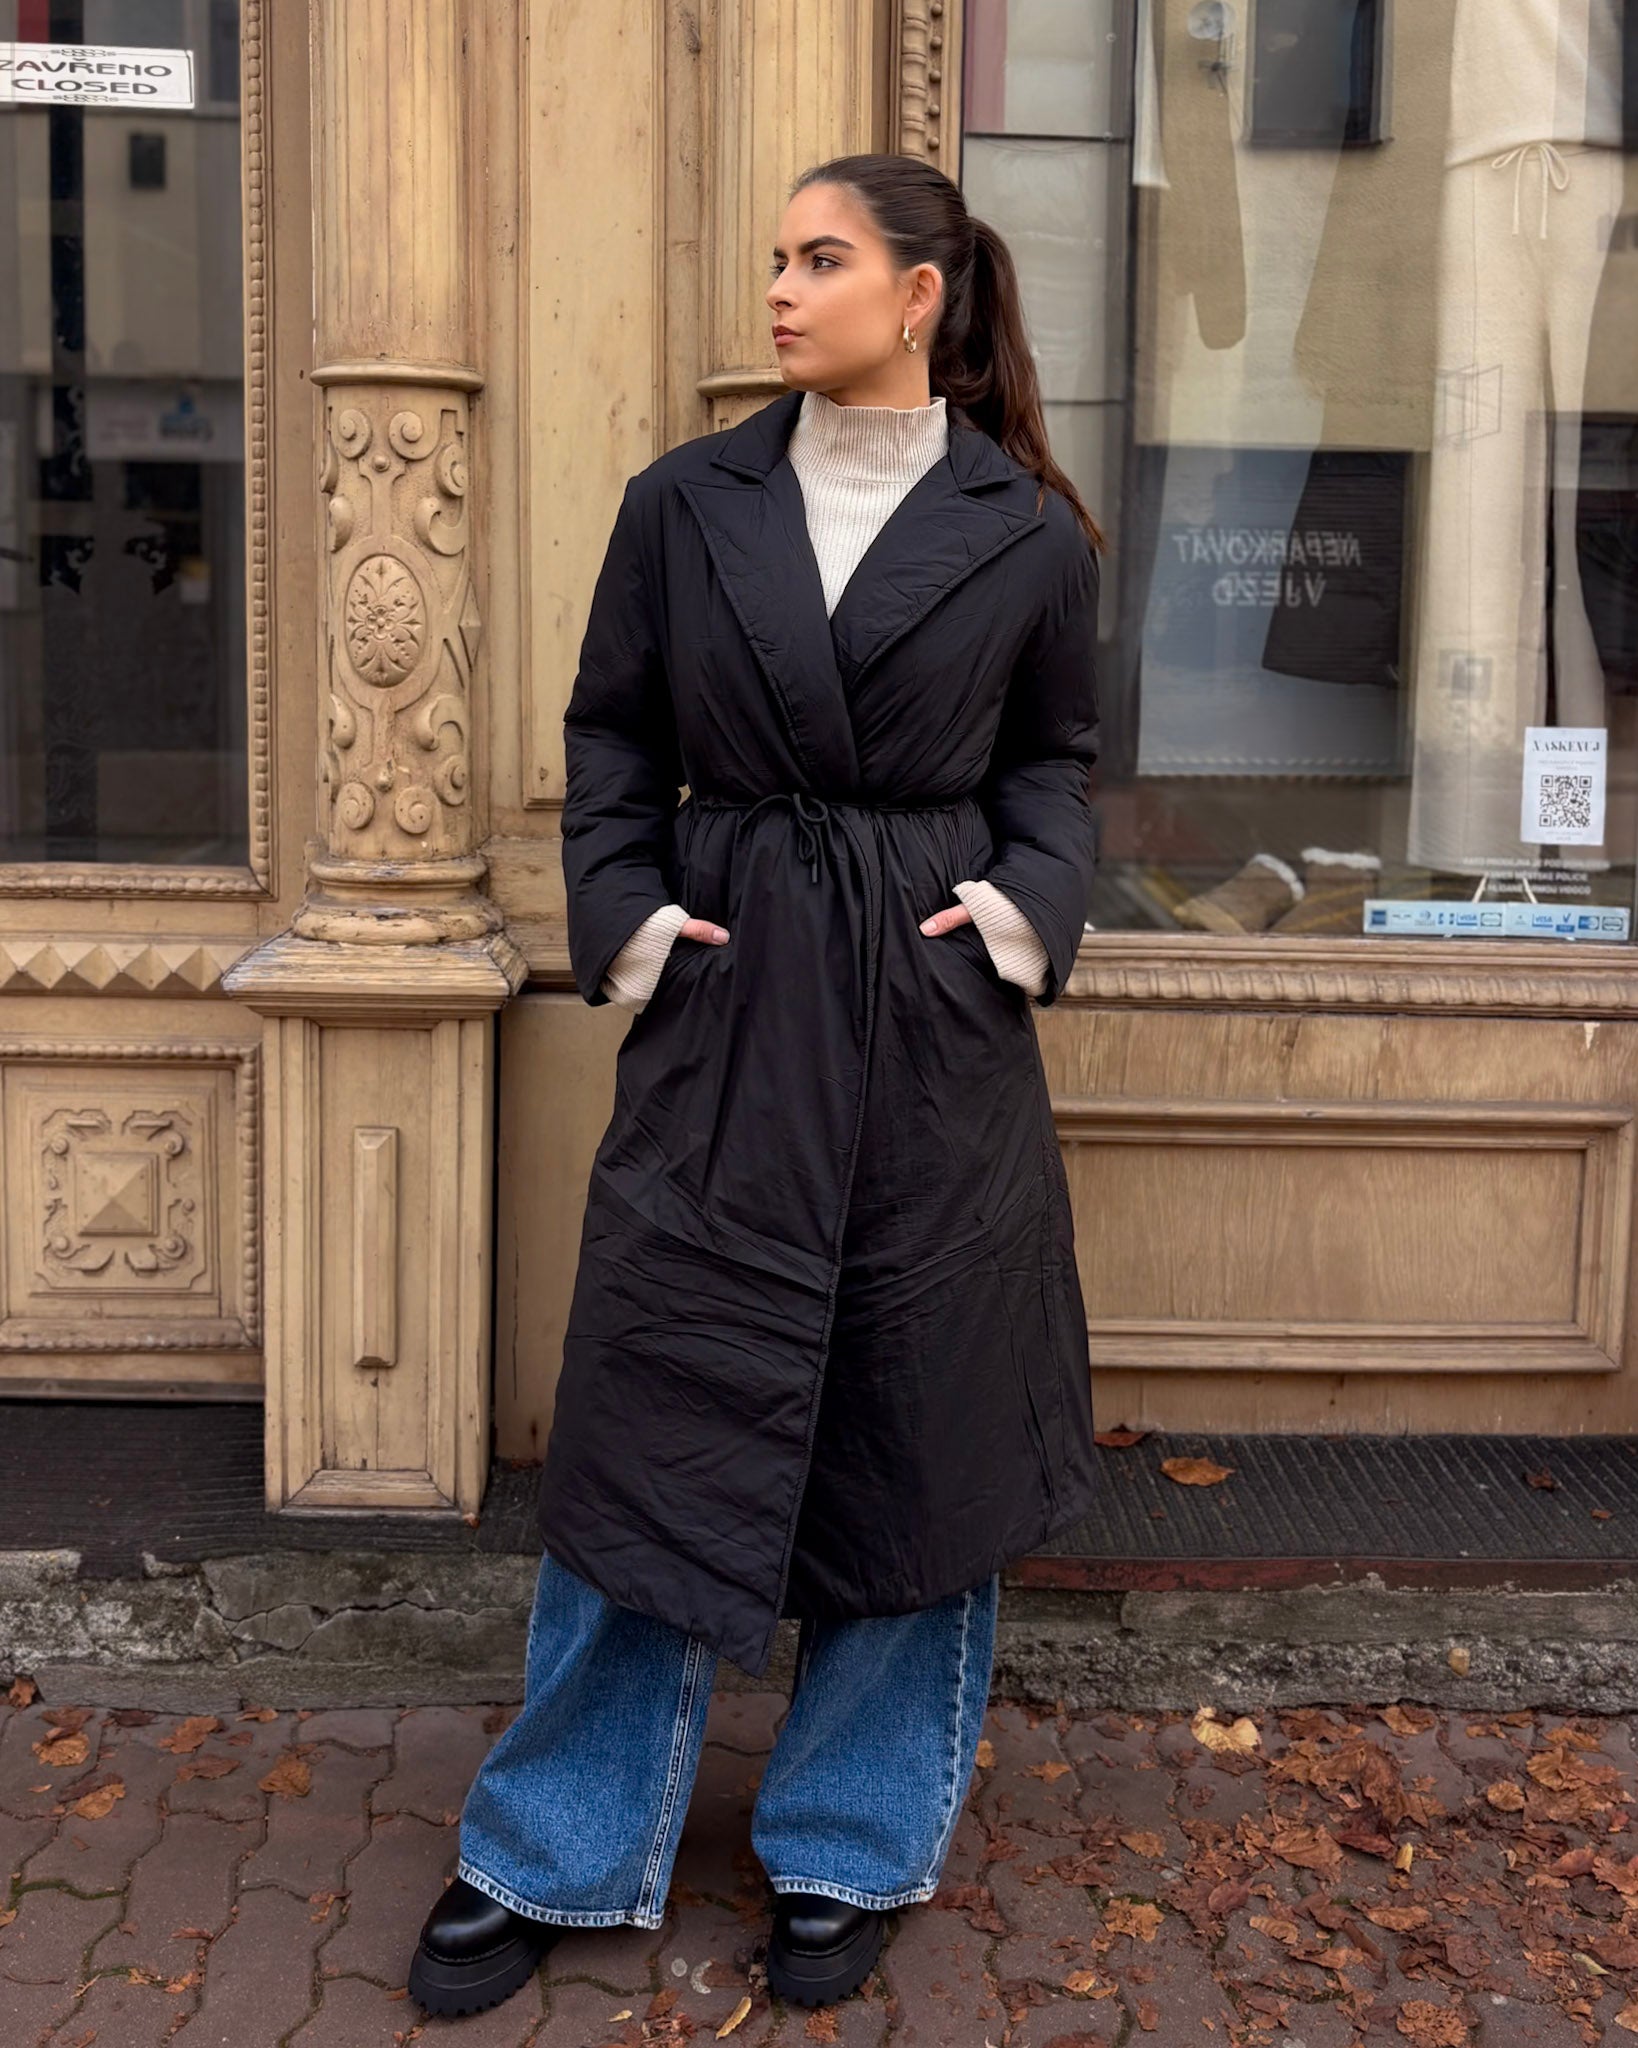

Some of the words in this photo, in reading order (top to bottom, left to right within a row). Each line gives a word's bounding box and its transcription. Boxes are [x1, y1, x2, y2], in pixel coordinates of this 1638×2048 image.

[0, 58, 172, 77] ZAVŘENO
[12, 79, 158, 95] CLOSED
[1532, 740, 1600, 752] NASKENUJ
